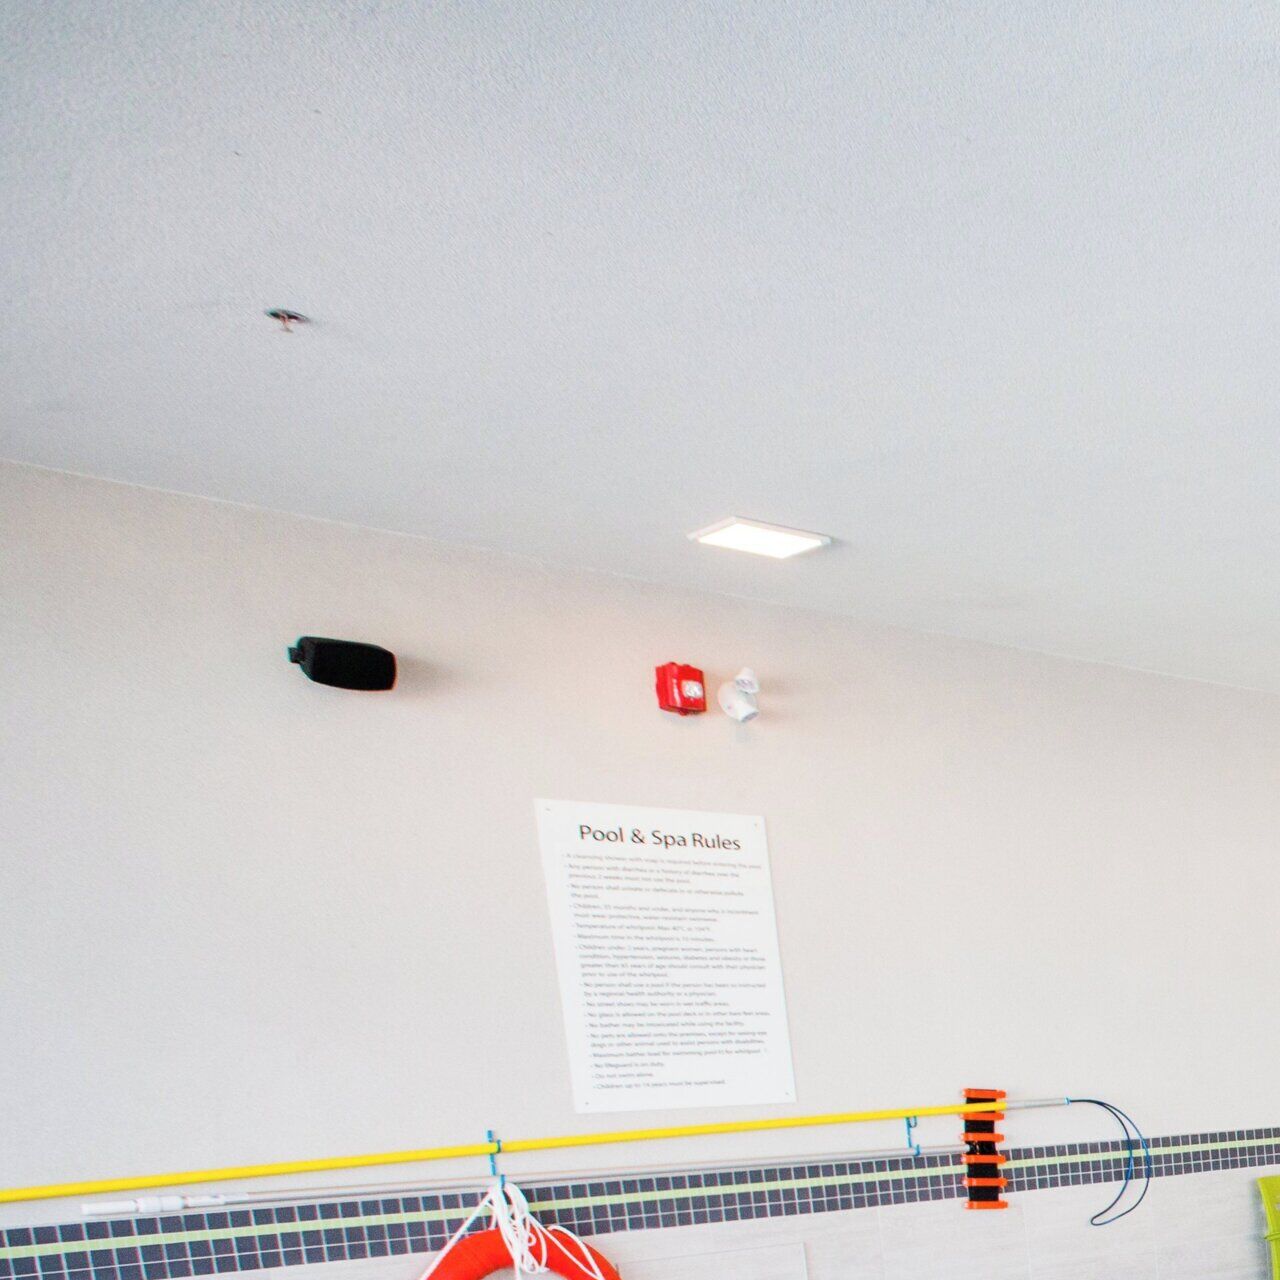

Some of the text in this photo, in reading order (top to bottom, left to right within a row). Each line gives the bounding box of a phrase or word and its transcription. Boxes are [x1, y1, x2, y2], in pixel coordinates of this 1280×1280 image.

[579, 825, 741, 850] Pool & Spa Rules
